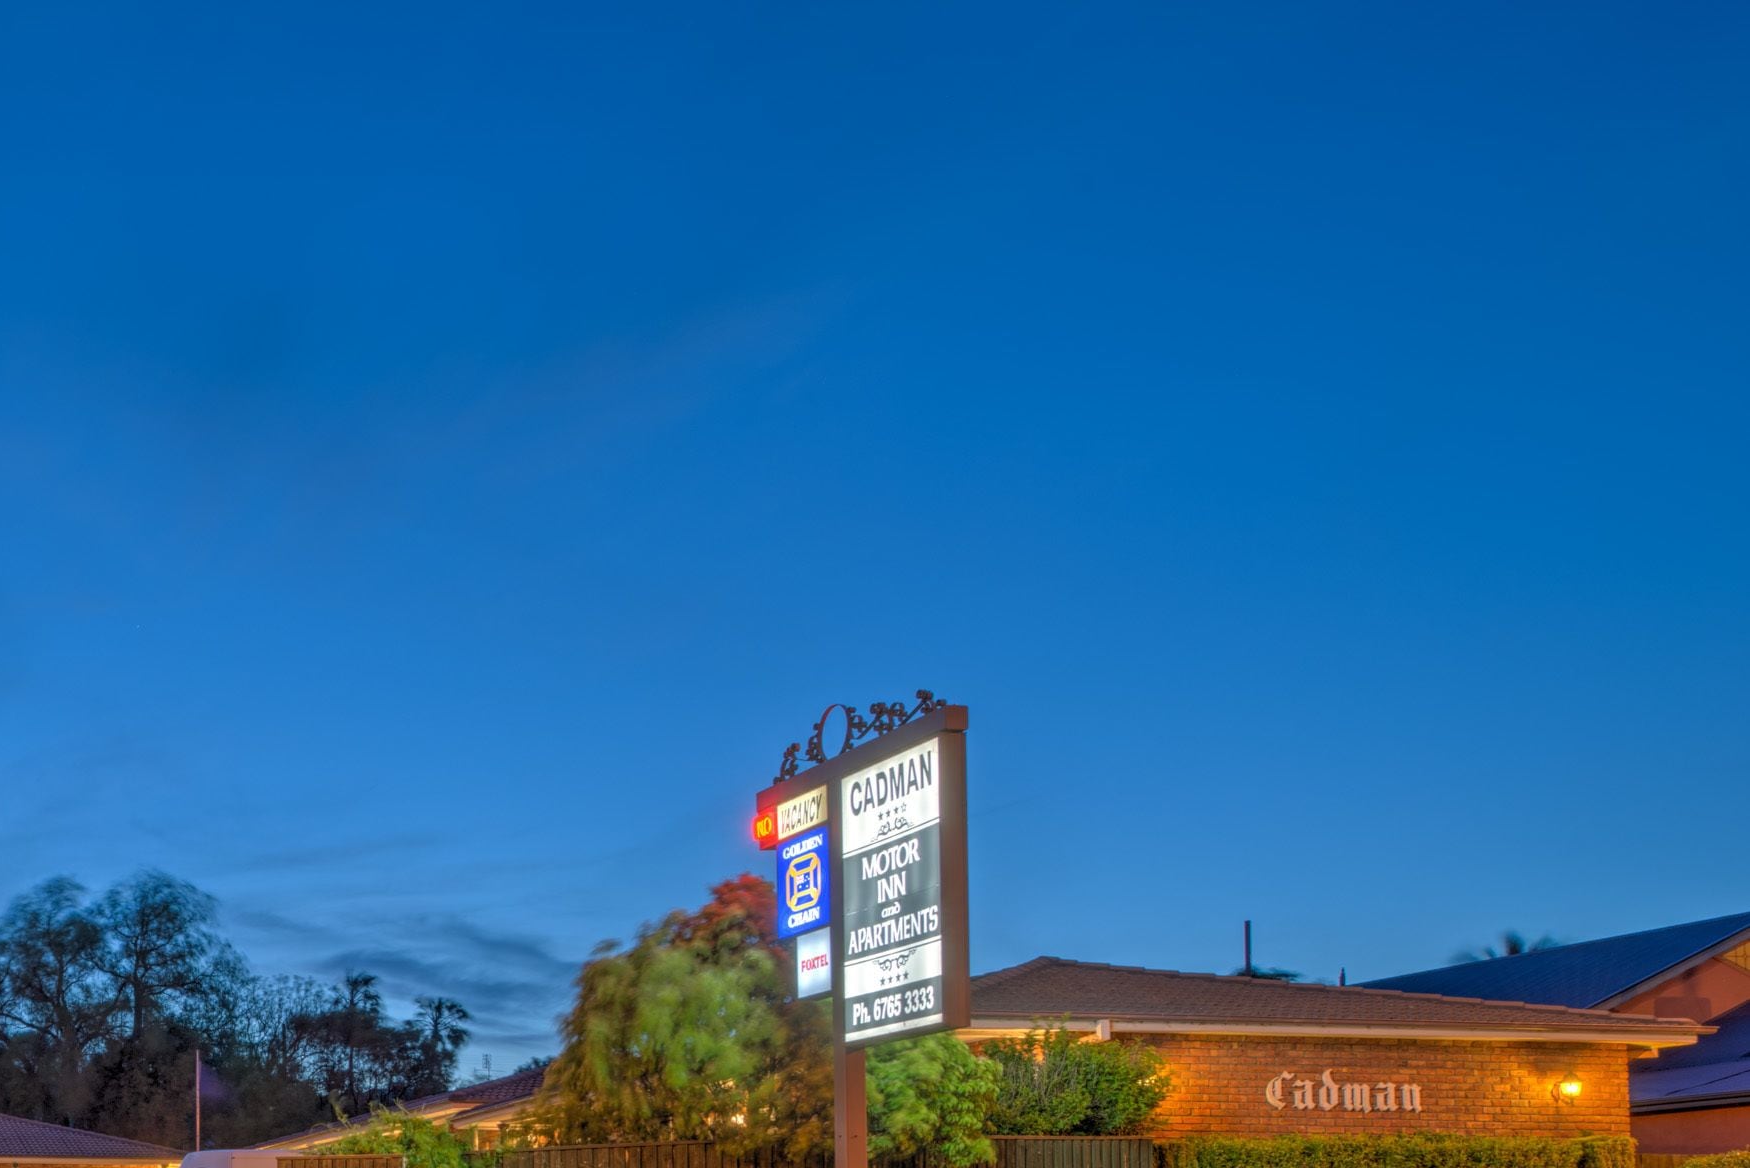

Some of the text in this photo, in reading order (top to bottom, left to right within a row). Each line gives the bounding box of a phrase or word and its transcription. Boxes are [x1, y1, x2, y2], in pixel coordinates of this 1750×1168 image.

[850, 750, 932, 817] CADMAN
[756, 793, 822, 838] NO VACANCY
[782, 833, 823, 860] GOLDEN
[861, 837, 921, 881] MOTOR
[877, 870, 907, 904] INN
[787, 906, 821, 929] CHAIN
[848, 905, 939, 955] APARTMENTS
[881, 901, 901, 919] and
[801, 953, 829, 973] FOXTEL
[852, 985, 934, 1026] Ph. 6765 3333
[1265, 1068, 1422, 1113] Cadman
